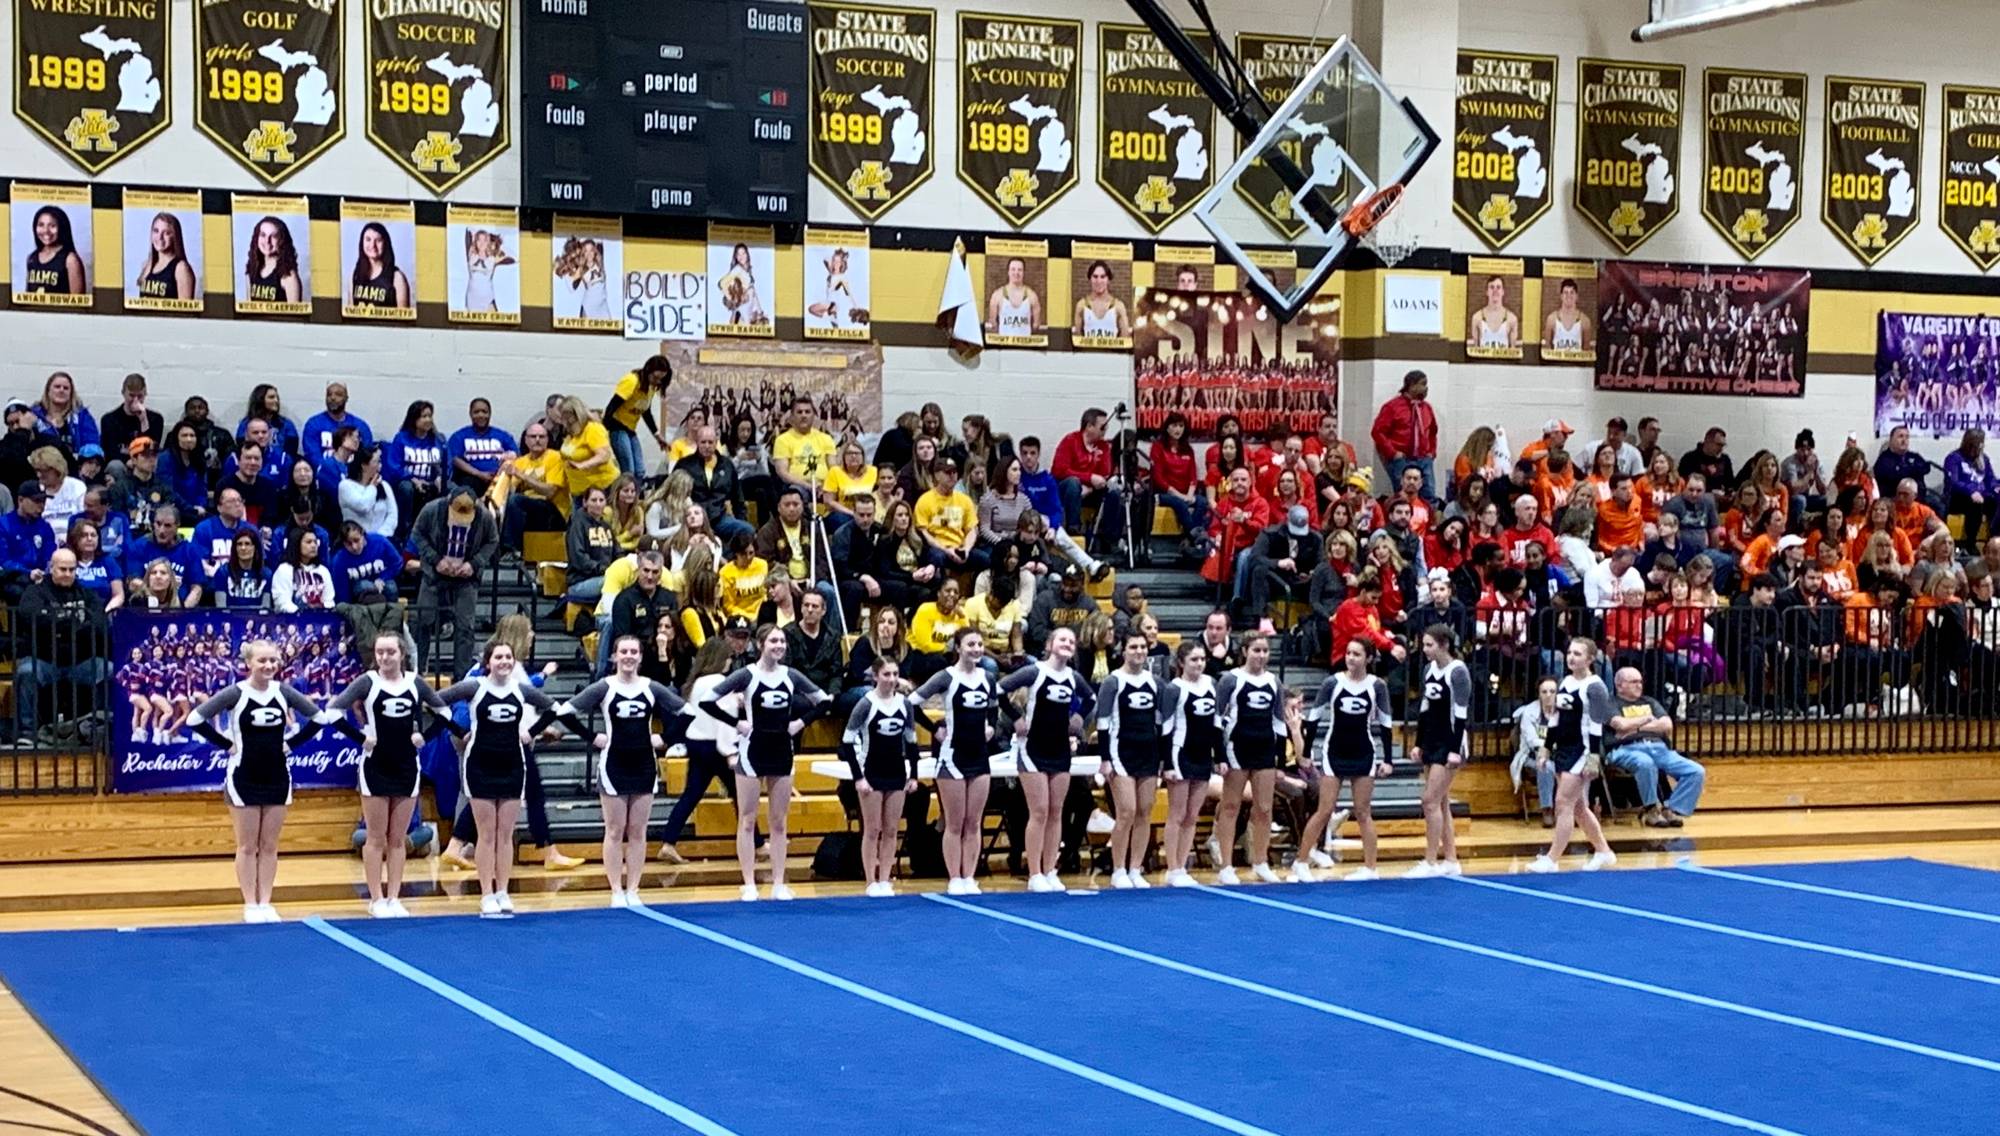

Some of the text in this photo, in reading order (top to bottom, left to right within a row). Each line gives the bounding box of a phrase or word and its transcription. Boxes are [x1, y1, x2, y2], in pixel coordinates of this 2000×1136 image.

[31, 0, 157, 20] WRESTLING
[373, 0, 502, 30] CHAMPIONS
[541, 0, 588, 16] Home
[243, 10, 298, 30] GOLF
[747, 8, 803, 33] Guests
[836, 11, 907, 34] STATE
[397, 23, 477, 45] SOCCER
[985, 22, 1055, 45] STATE
[1126, 33, 1166, 53] STA
[206, 42, 255, 66] girls
[814, 28, 929, 64] CHAMPIONS
[965, 38, 1075, 72] RUNNER-UP
[29, 54, 106, 92] 1999
[376, 54, 423, 77] girls
[836, 57, 906, 78] SOCCER
[1106, 49, 1182, 77] RUNNER
[1472, 58, 1533, 80] STATE
[209, 67, 284, 104] 1999
[645, 73, 698, 94] period
[970, 67, 1070, 89] X-COUNTRY
[1106, 77, 1204, 98] GYMNASTIC
[1603, 67, 1661, 88] STATE
[1728, 76, 1784, 97] STATE
[379, 80, 451, 116] 1999
[820, 86, 855, 110] boys
[1263, 87, 1325, 105] SOCER
[1456, 75, 1551, 106] RUNNER-UP
[1584, 83, 1679, 114] CHAMPIONS
[1848, 85, 1903, 104] STATE
[546, 103, 585, 126] fouls
[967, 97, 1006, 119] girls
[1459, 101, 1545, 120] SWIMMING
[1710, 92, 1801, 122] CHAMPIONS
[1832, 101, 1919, 130] CHAMPIONS
[645, 110, 698, 134] player
[755, 118, 792, 140] fouls
[819, 111, 883, 145] 1999
[1584, 109, 1678, 128] GYMNASTICS
[1710, 117, 1800, 136] GYMNASTICS
[968, 121, 1030, 154] 1999
[1457, 128, 1487, 150] boys
[1841, 125, 1911, 143] FOOTBALL
[1109, 130, 1167, 162] 2001
[1456, 150, 1515, 182] 2002
[1587, 158, 1643, 188] 2002
[1949, 160, 1982, 175] MCCA
[1710, 165, 1764, 194] 2003
[1831, 172, 1884, 201] 2003
[550, 182, 583, 200] won
[651, 187, 693, 208] game
[1946, 179, 1998, 208] 2004
[756, 195, 788, 212] won
[29, 269, 59, 287] DAMS
[625, 271, 700, 300] BOLD
[1392, 298, 1439, 311] ADAMS
[626, 300, 695, 336] SIDE
[1901, 315, 1977, 336] VARSITY
[1599, 375, 1800, 395] COMPETITIVE CHEER
[1136, 411, 1168, 430] TRO
[760, 690, 790, 709] E
[962, 690, 990, 709] E
[1046, 683, 1074, 703] E
[1127, 691, 1155, 709] E
[1247, 690, 1274, 709] E
[383, 697, 414, 718] E
[487, 703, 519, 722] E
[615, 699, 647, 718] E
[1192, 697, 1216, 716] E
[1339, 696, 1369, 715] E
[250, 706, 283, 727] E
[877, 717, 906, 736] E
[122, 747, 362, 774] Rochester Fa arsity Che
